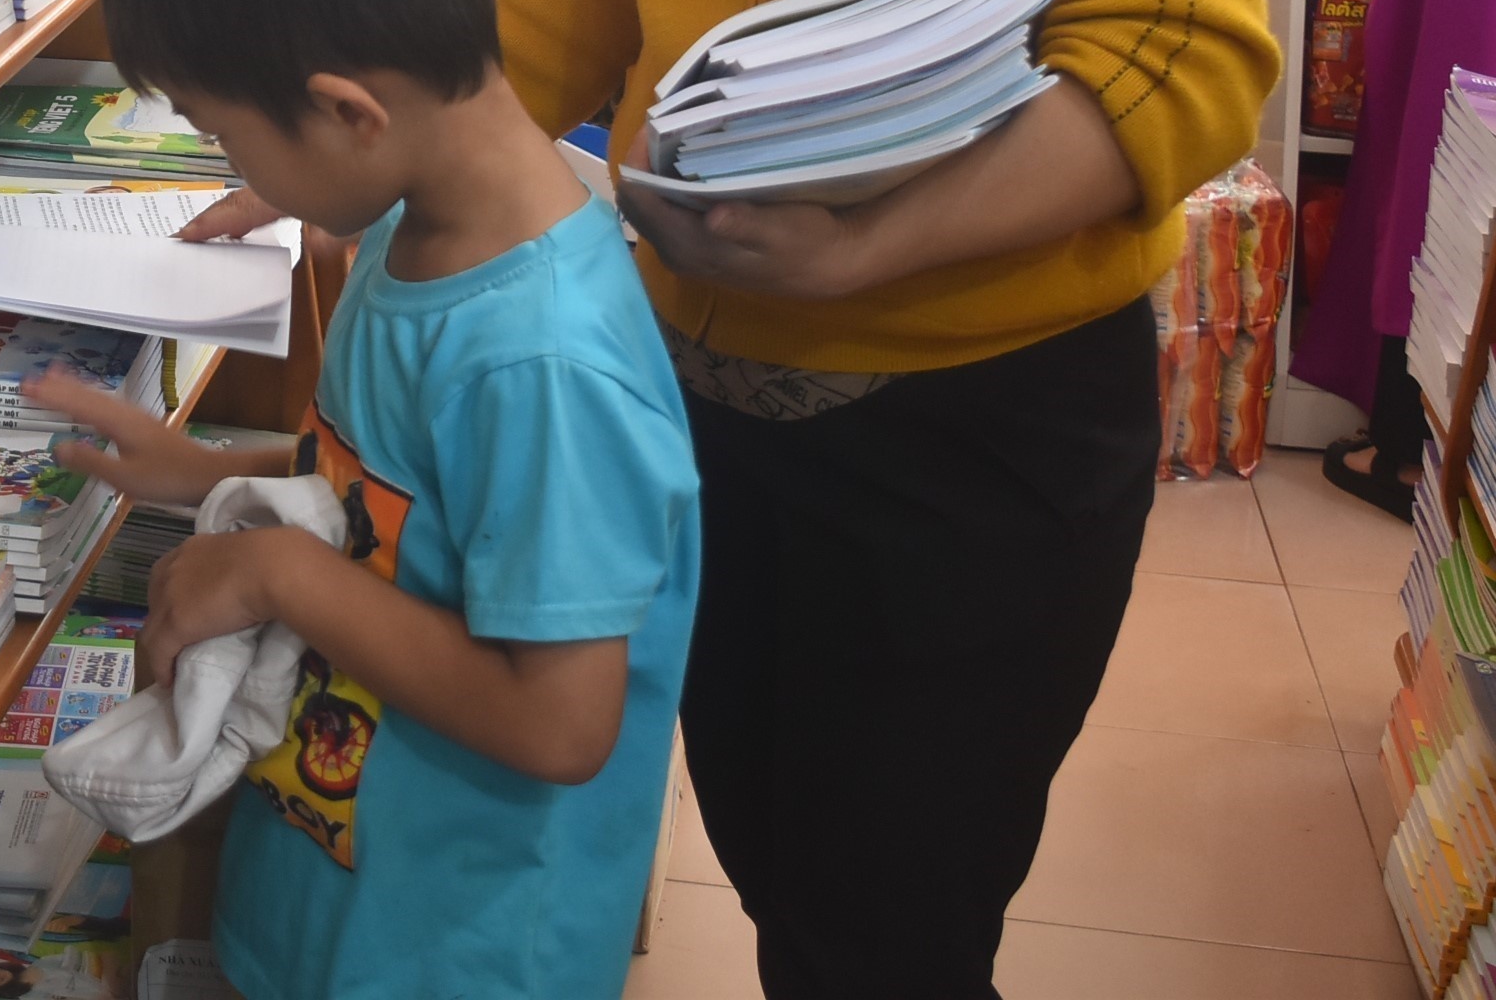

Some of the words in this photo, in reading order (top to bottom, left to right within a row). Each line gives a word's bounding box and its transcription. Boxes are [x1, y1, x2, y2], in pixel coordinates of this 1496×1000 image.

[4, 419, 17, 428] MỘT
[260, 775, 347, 850] BOY
[159, 954, 186, 966] NHÀ
